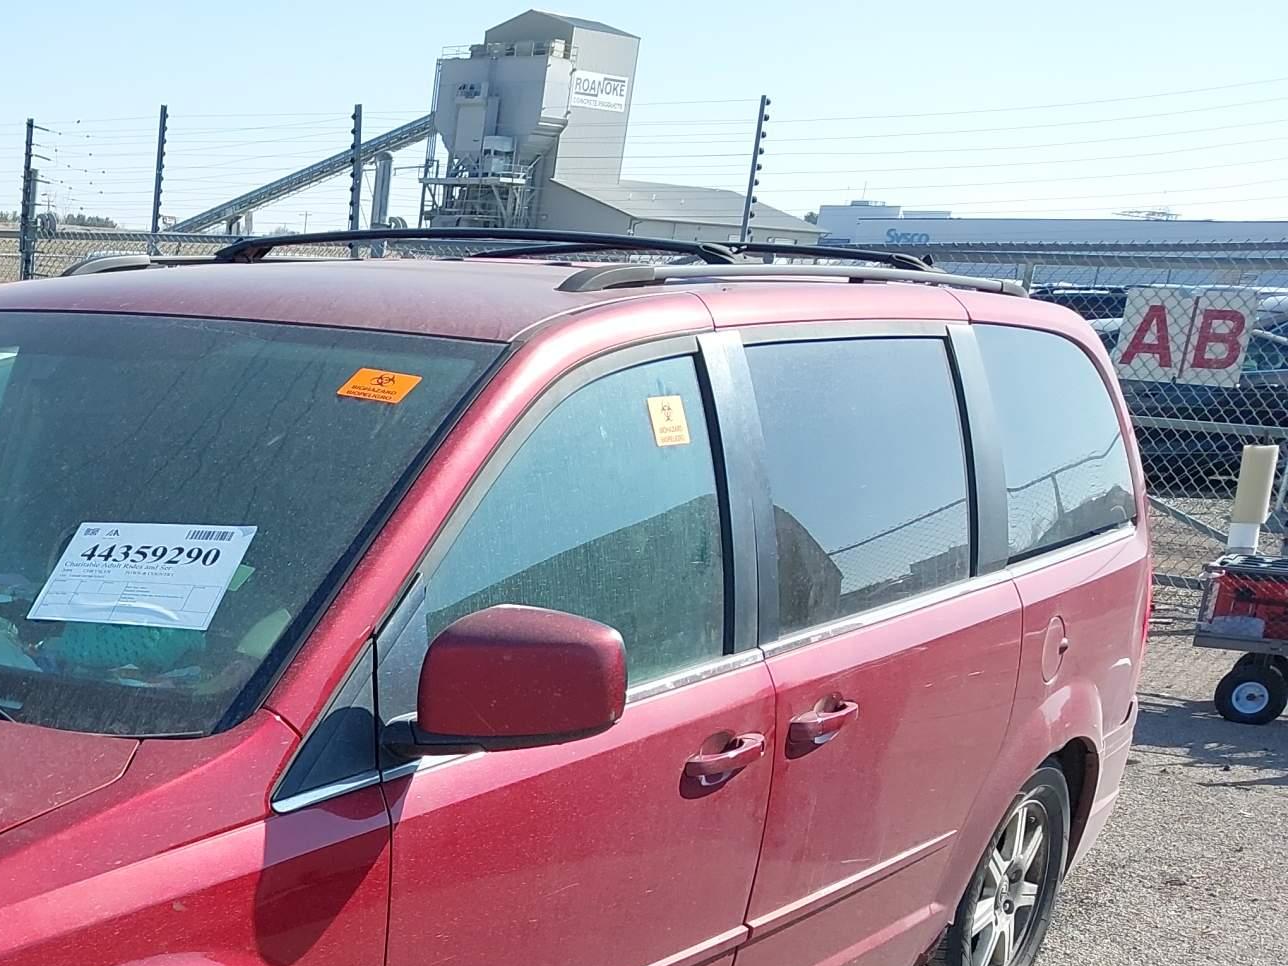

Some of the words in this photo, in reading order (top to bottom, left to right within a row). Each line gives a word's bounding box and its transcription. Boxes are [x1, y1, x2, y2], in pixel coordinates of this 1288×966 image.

[574, 77, 626, 97] ROANOKE
[885, 228, 930, 243] Sysco
[1118, 304, 1172, 368] A
[1190, 309, 1246, 370] B
[346, 390, 392, 400] BIOPELIGRO
[351, 385, 397, 395] BIOHAZARD
[81, 543, 221, 566] 44359290
[64, 560, 101, 568] Charitable
